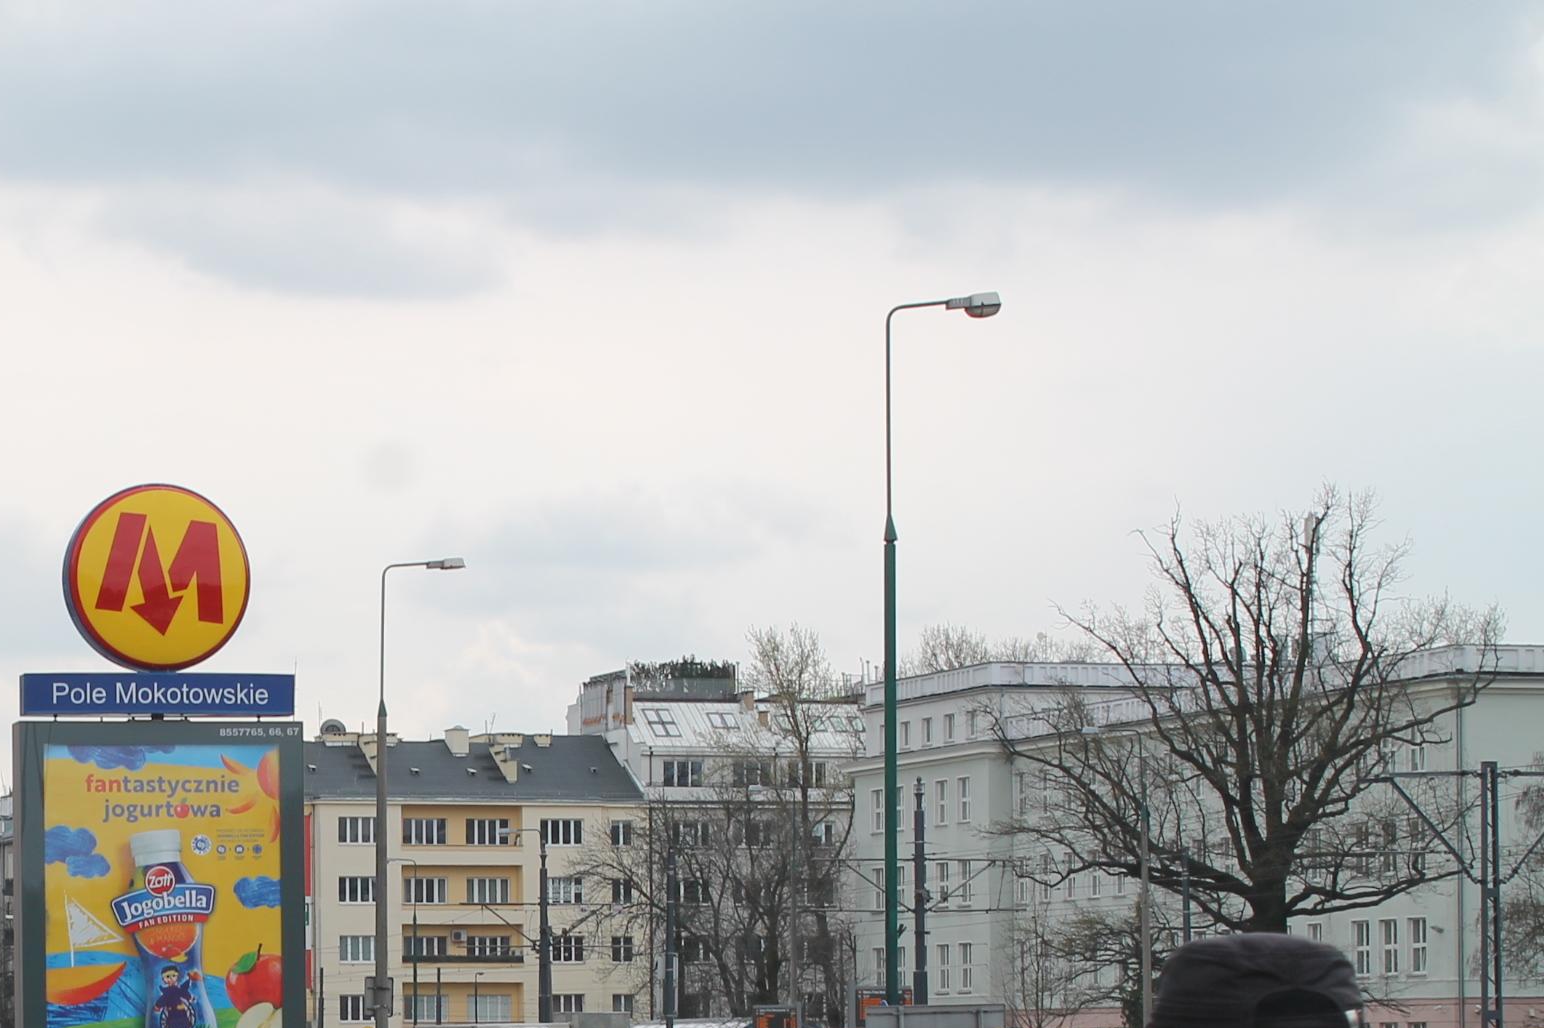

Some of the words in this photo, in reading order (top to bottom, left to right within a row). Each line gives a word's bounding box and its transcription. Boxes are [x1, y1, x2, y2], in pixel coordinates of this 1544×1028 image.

[52, 682, 106, 704] Pole
[115, 682, 269, 704] Mokotowskie
[286, 727, 300, 736] 67
[85, 774, 240, 798] fantastycznie
[148, 873, 172, 889] Zott
[121, 890, 207, 921] Jogobella
[138, 918, 155, 929] FAN
[157, 914, 194, 924] EDITION
